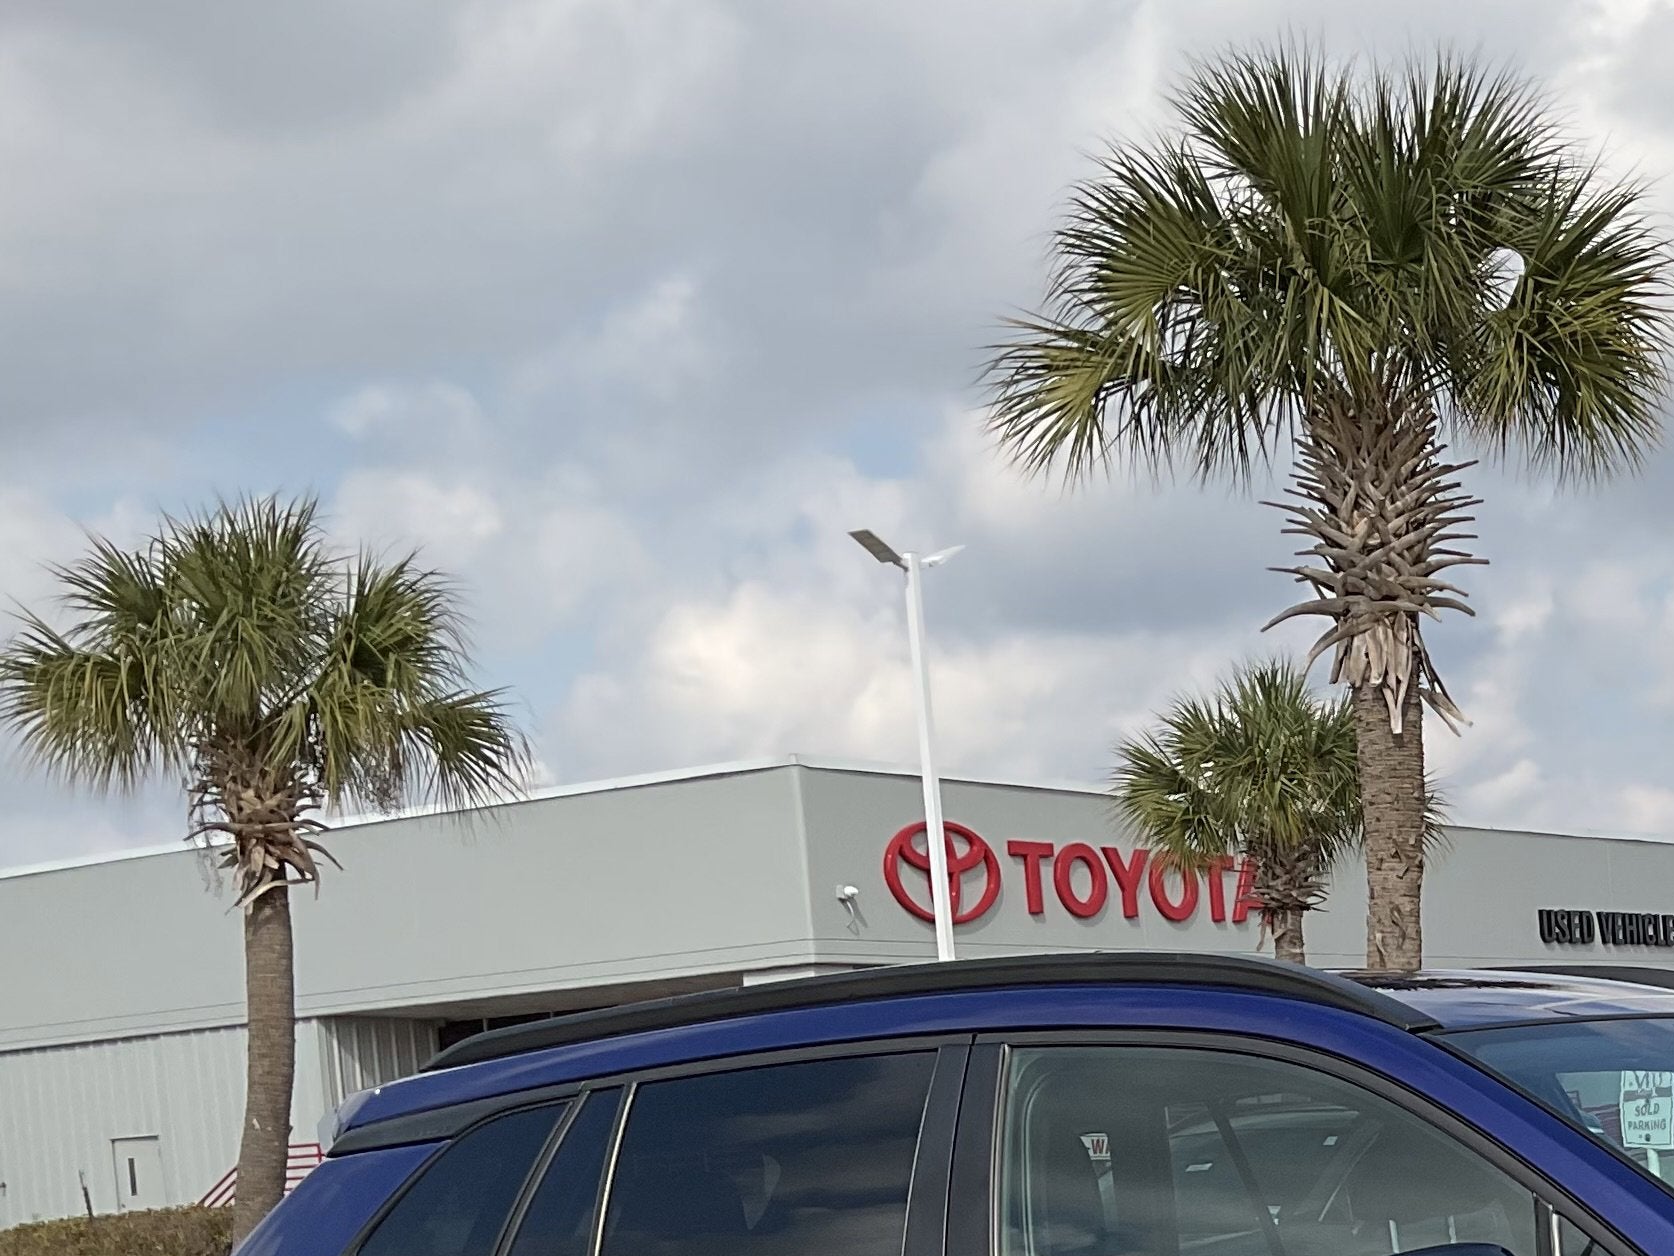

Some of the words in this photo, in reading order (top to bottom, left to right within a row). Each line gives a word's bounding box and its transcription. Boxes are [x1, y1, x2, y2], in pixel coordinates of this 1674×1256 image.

[1538, 909, 1596, 944] USED
[1634, 1103, 1660, 1117] SOLD
[1627, 1118, 1667, 1131] PARKING
